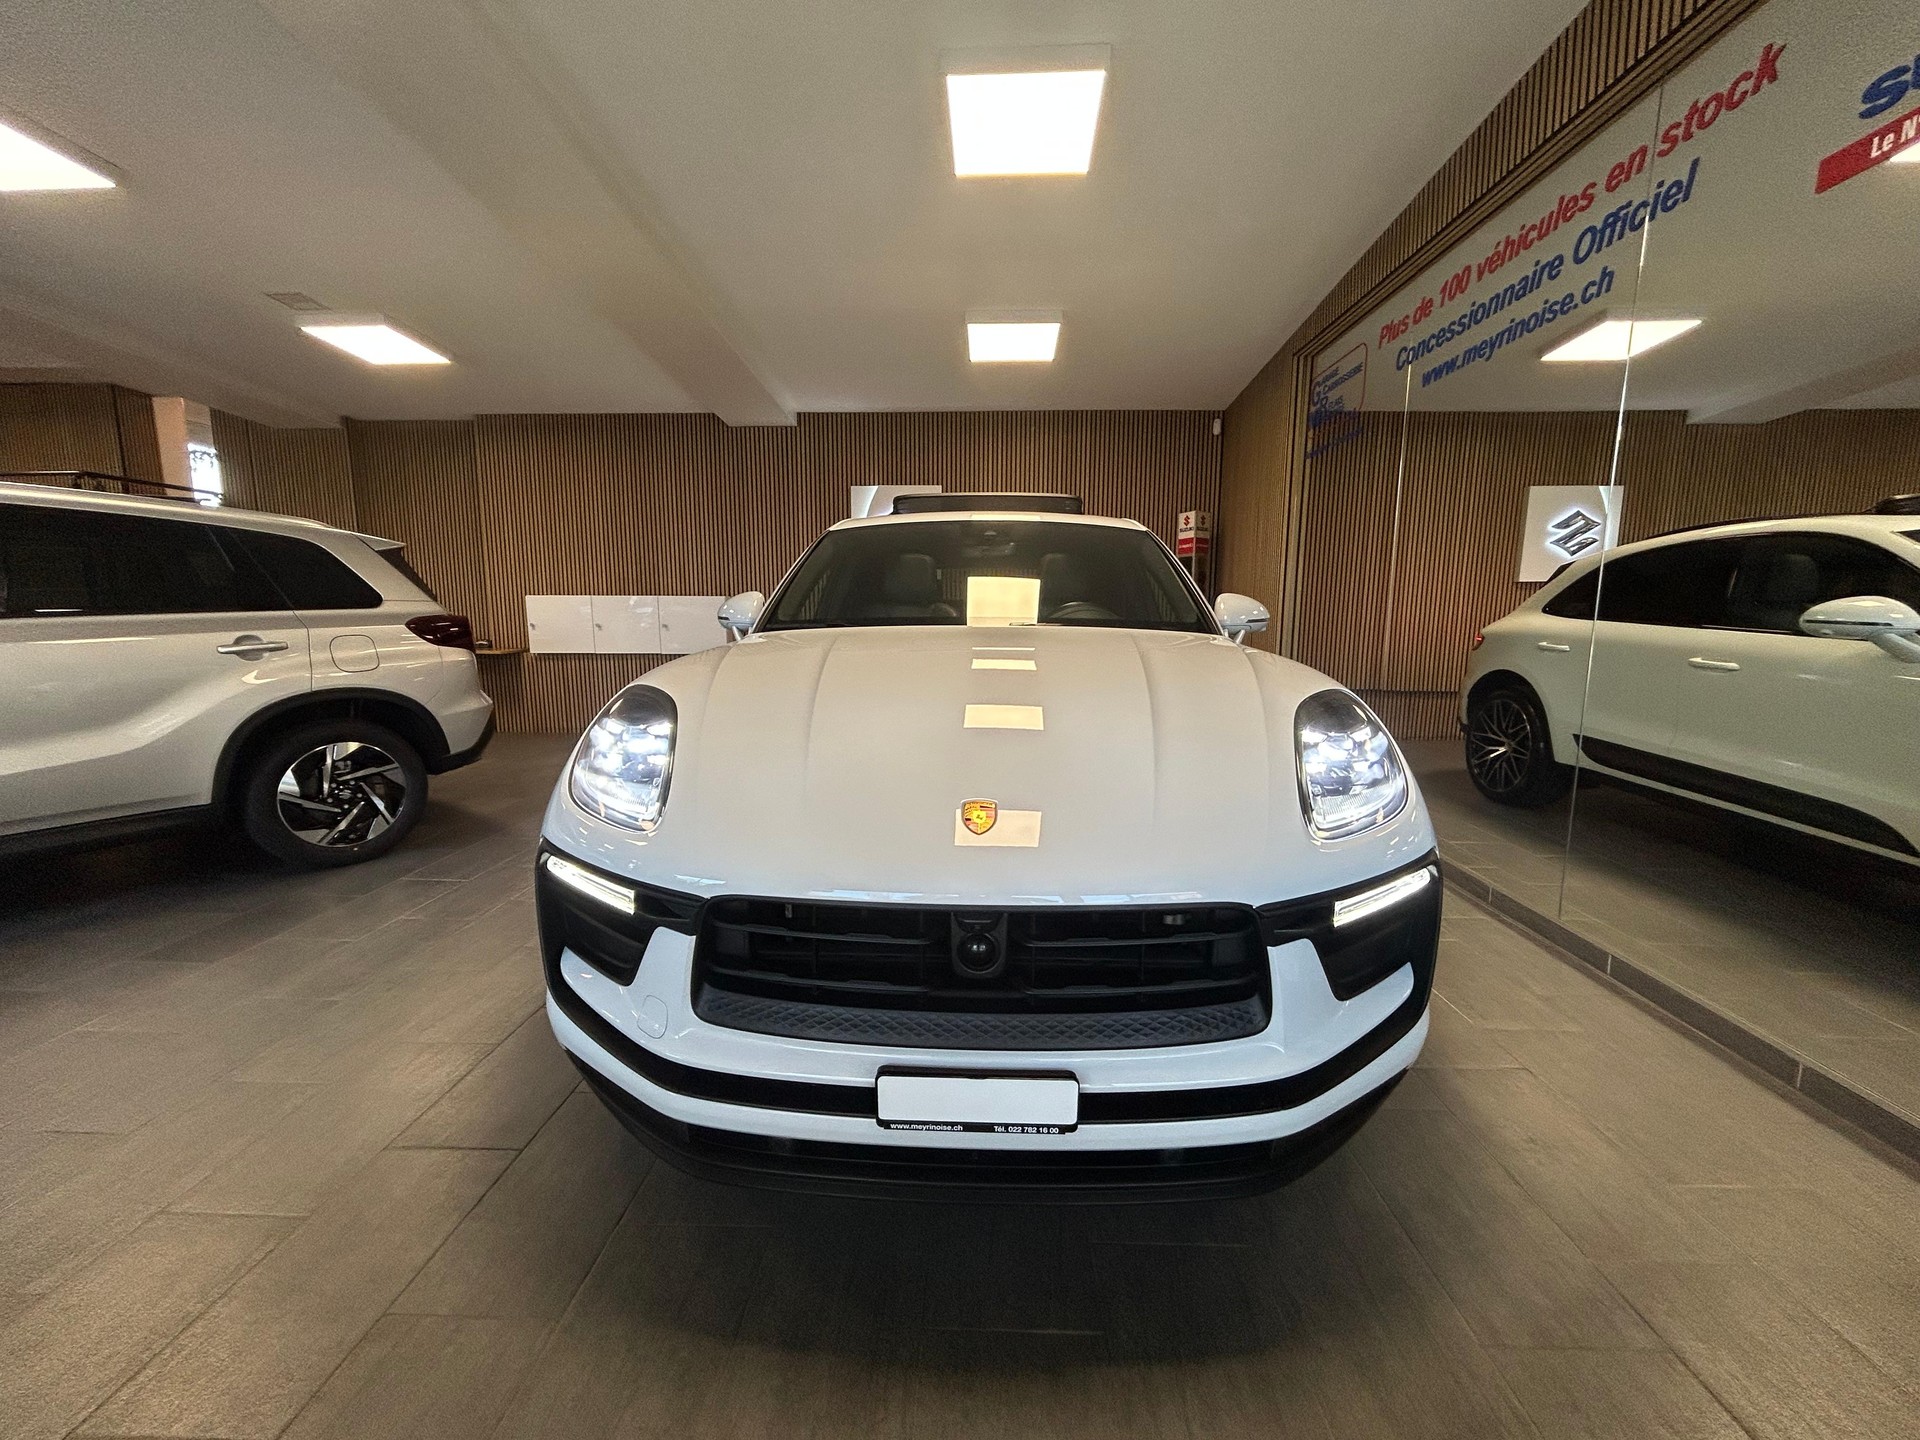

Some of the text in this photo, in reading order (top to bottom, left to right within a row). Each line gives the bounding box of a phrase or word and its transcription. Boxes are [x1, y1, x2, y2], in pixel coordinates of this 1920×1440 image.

[1858, 53, 1920, 119] S
[1869, 114, 1920, 158] Le N
[1379, 42, 1788, 349] Plus de 100 véhicules en stock
[1396, 156, 1700, 371] Concessionnaire Officiel
[1422, 265, 1615, 388] www.meyrinoise.ch
[890, 1123, 963, 1131] www.meyrinoise.ch
